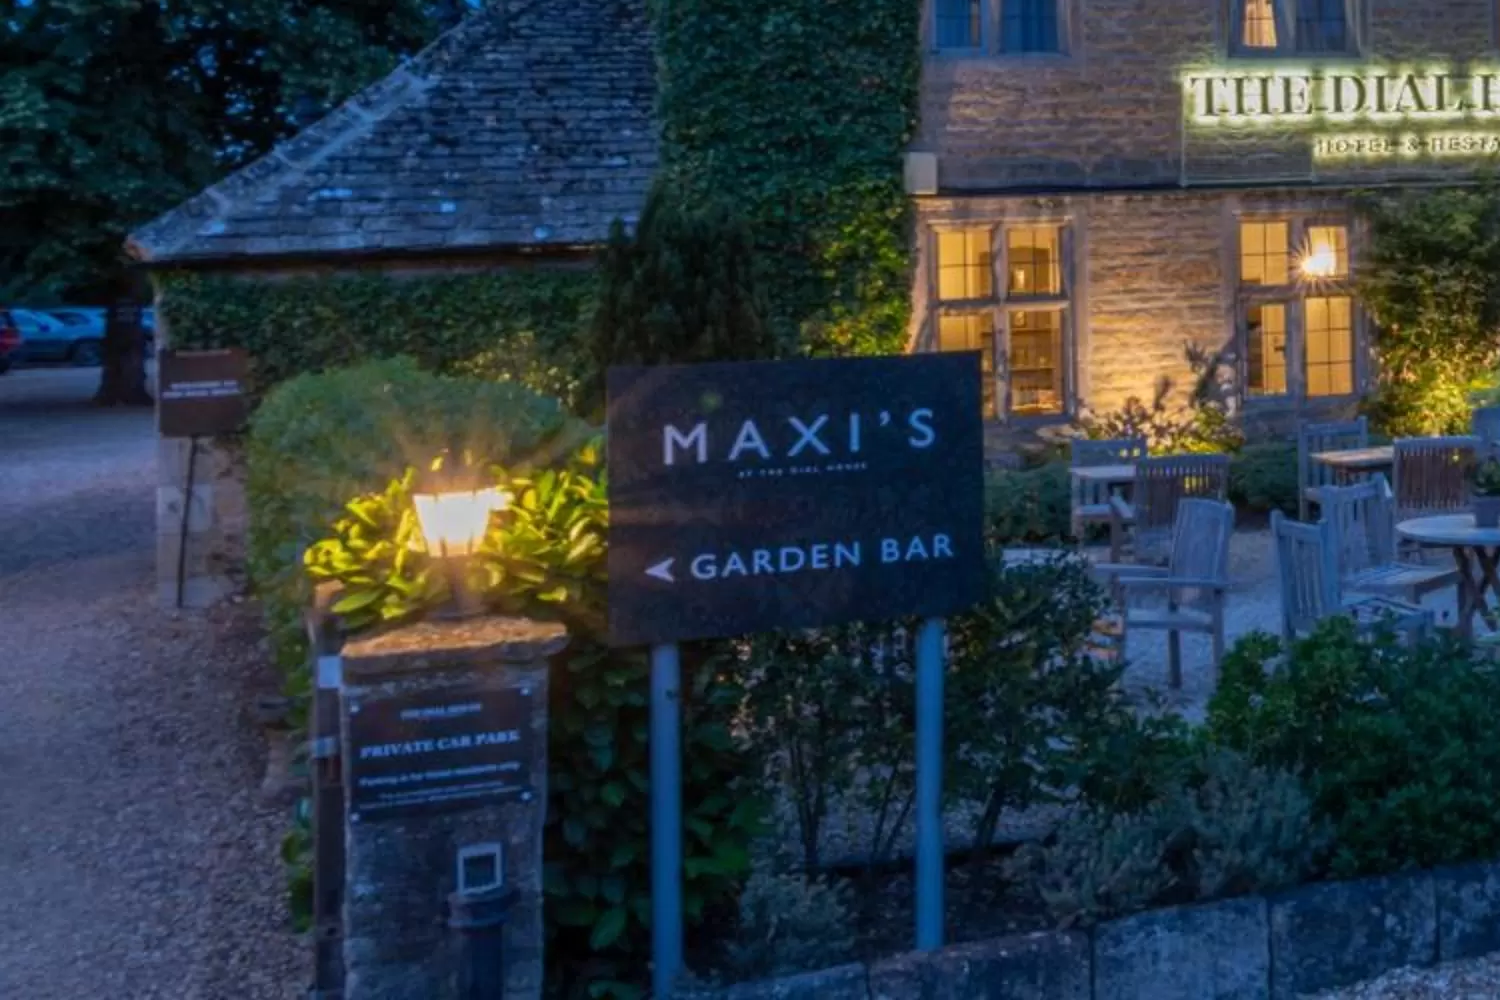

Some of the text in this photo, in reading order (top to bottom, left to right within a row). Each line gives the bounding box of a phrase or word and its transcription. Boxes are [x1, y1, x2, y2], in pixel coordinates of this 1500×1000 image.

[1190, 75, 1313, 115] THE
[1327, 73, 1463, 112] DIAL
[1318, 137, 1393, 153] HOTEL
[1407, 137, 1421, 152] &
[663, 407, 936, 466] MAXI'S
[690, 533, 954, 580] GARDEN BAR
[360, 739, 434, 759] PRIVATE
[437, 734, 472, 750] CAR
